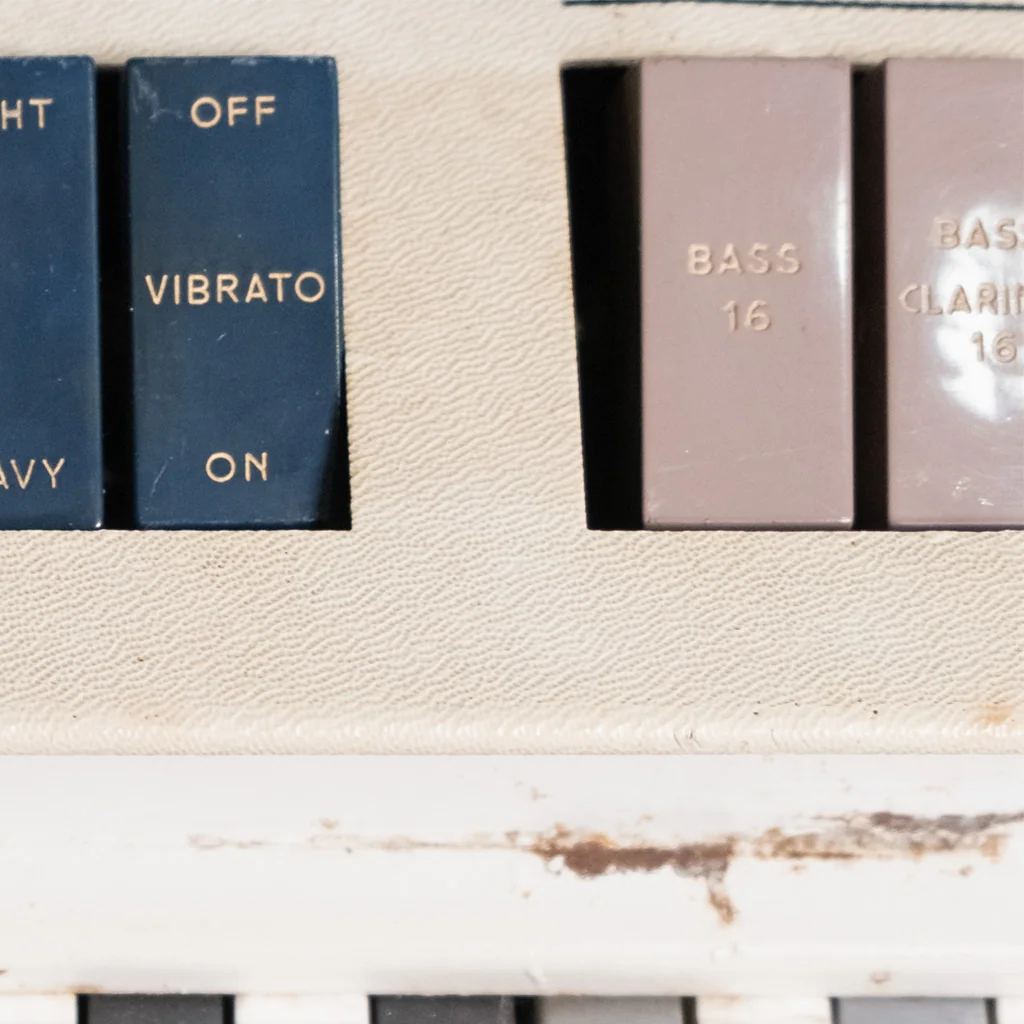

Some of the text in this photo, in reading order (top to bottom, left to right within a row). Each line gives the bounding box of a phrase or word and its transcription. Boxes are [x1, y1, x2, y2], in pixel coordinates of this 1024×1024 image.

[190, 95, 276, 129] OFF
[933, 216, 1024, 250] BAS
[686, 243, 802, 277] BASS
[144, 271, 326, 306] VIBRATO
[721, 299, 773, 333] 16
[971, 330, 1018, 364] 16
[205, 451, 269, 484] ON
